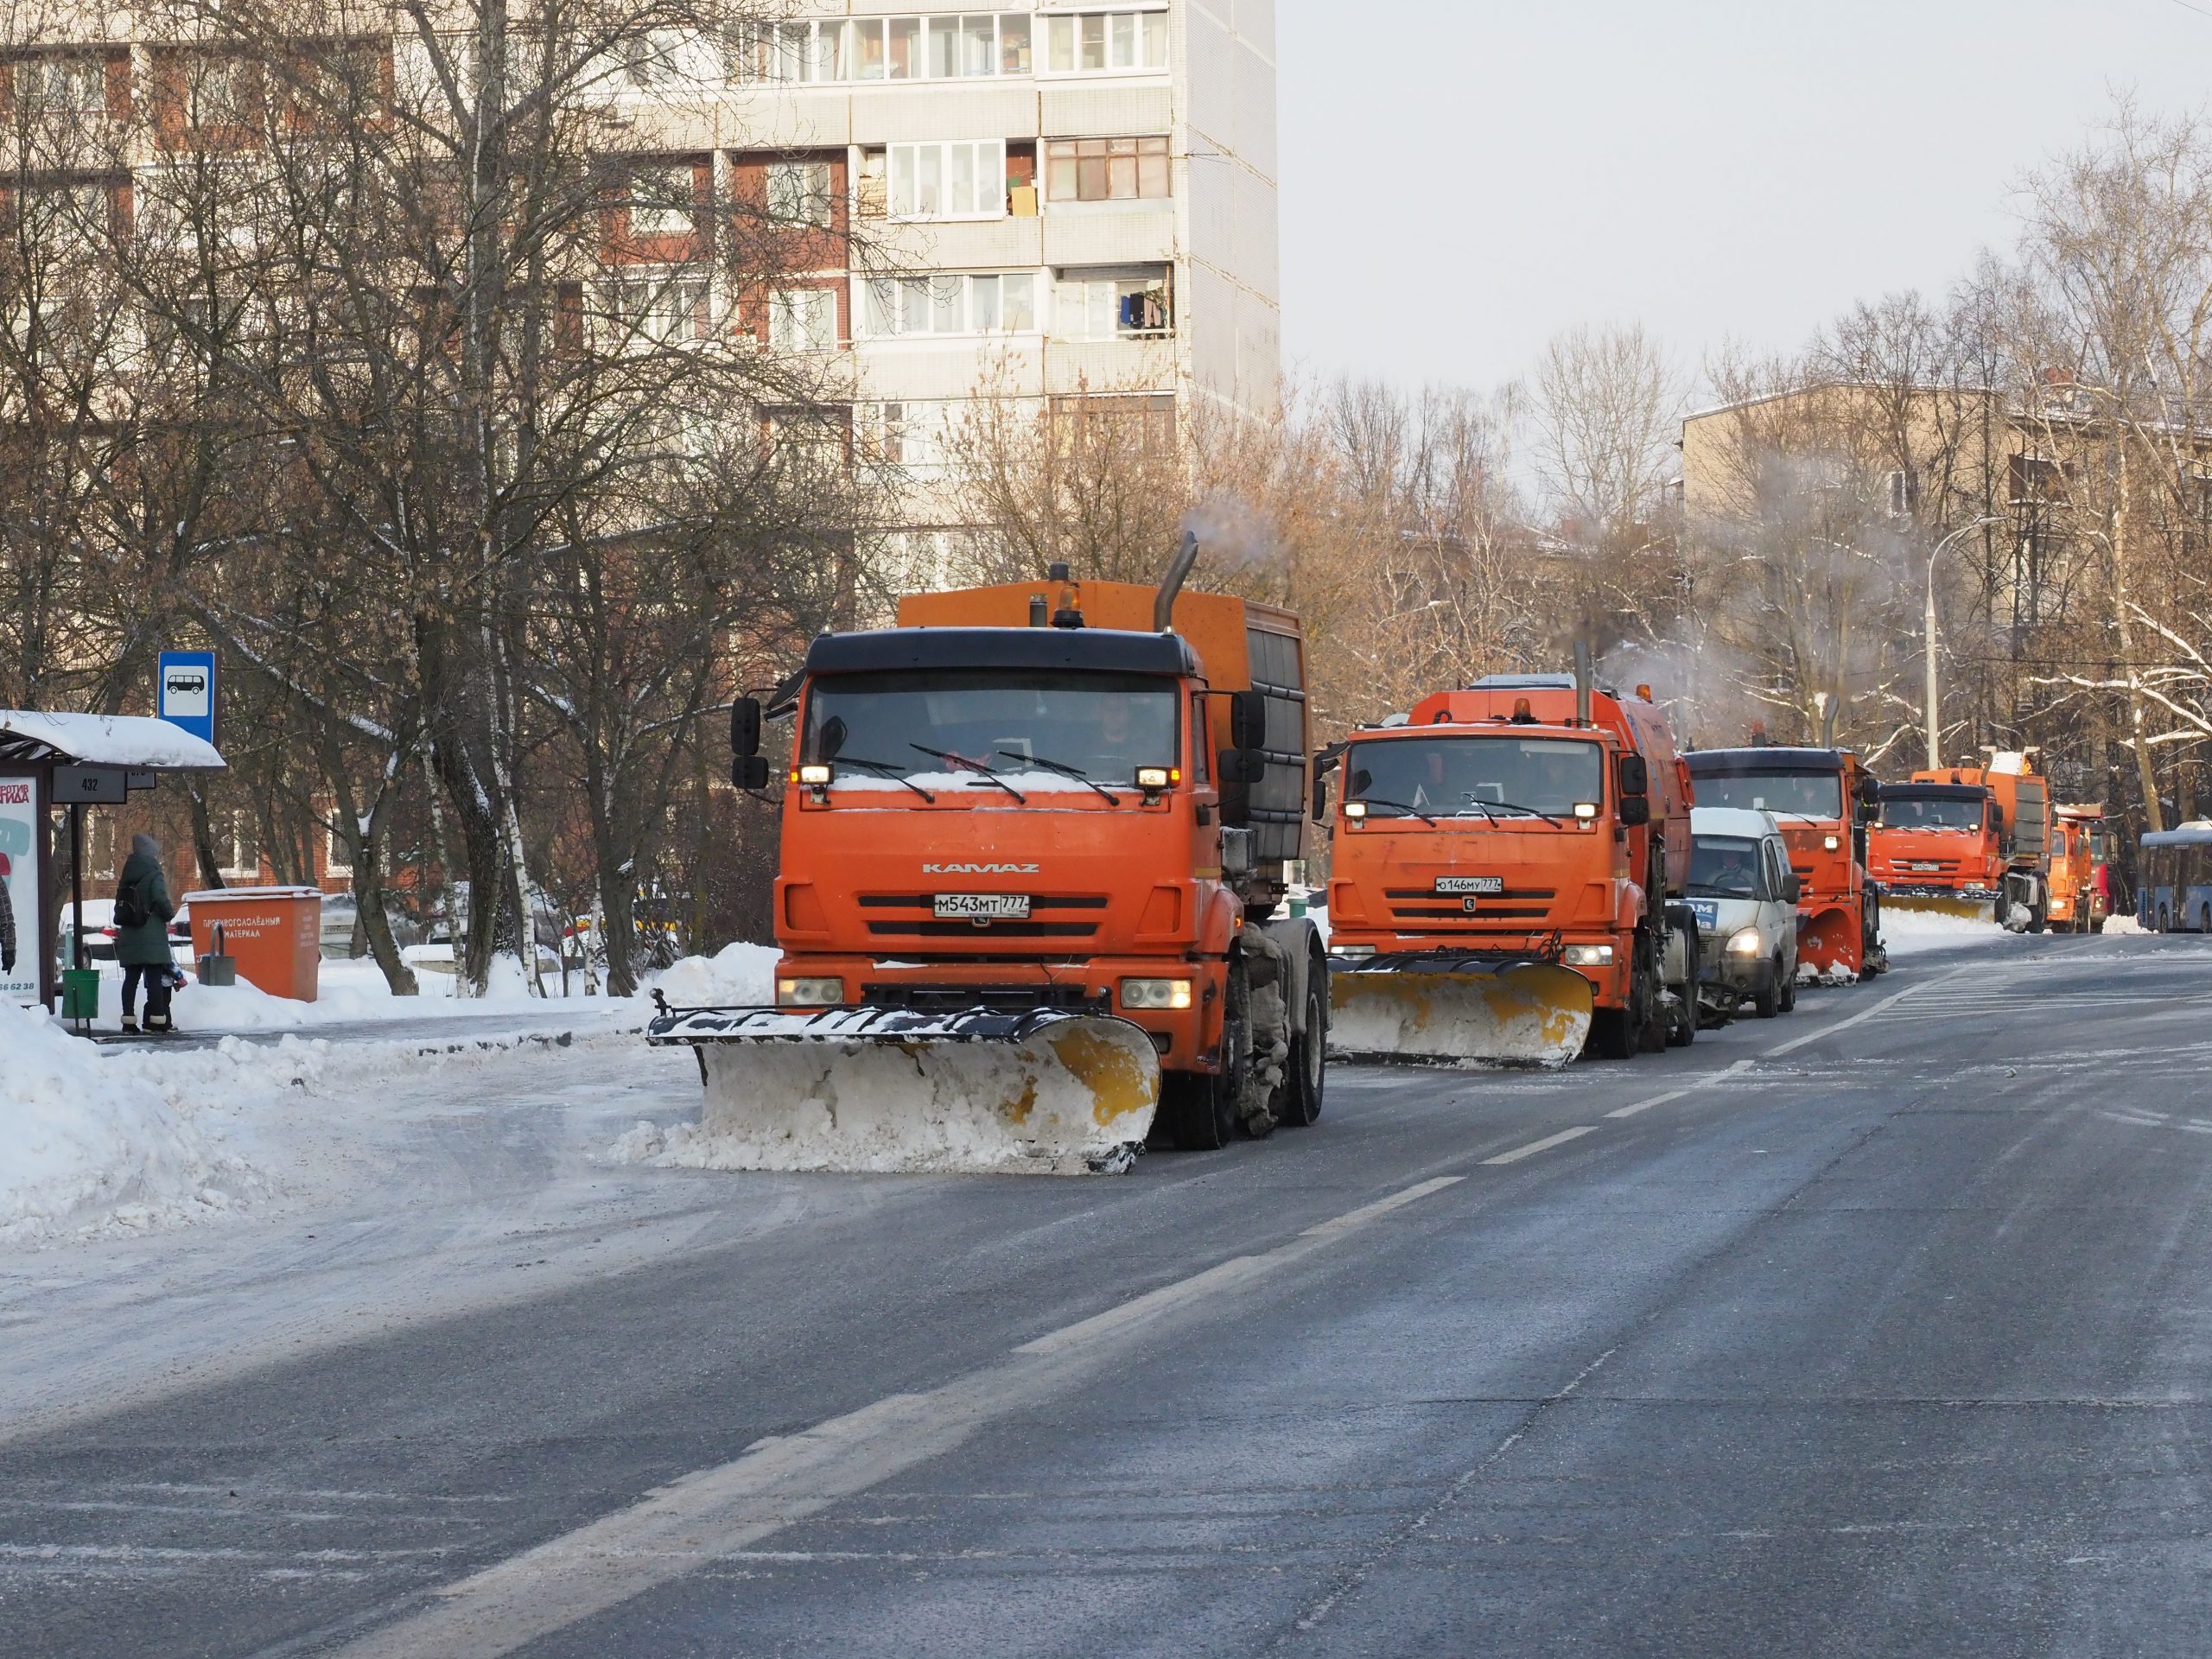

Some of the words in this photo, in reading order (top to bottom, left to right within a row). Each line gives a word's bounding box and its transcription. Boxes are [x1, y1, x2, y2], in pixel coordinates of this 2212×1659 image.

[82, 779, 98, 791] 432
[0, 793, 29, 804] ПИДА
[923, 864, 1039, 873] KAMAZ
[1483, 879, 1498, 887] 777
[938, 896, 999, 912] М543МТ
[1002, 896, 1025, 908] 777
[224, 929, 260, 938] МАТЕРИАЛ
